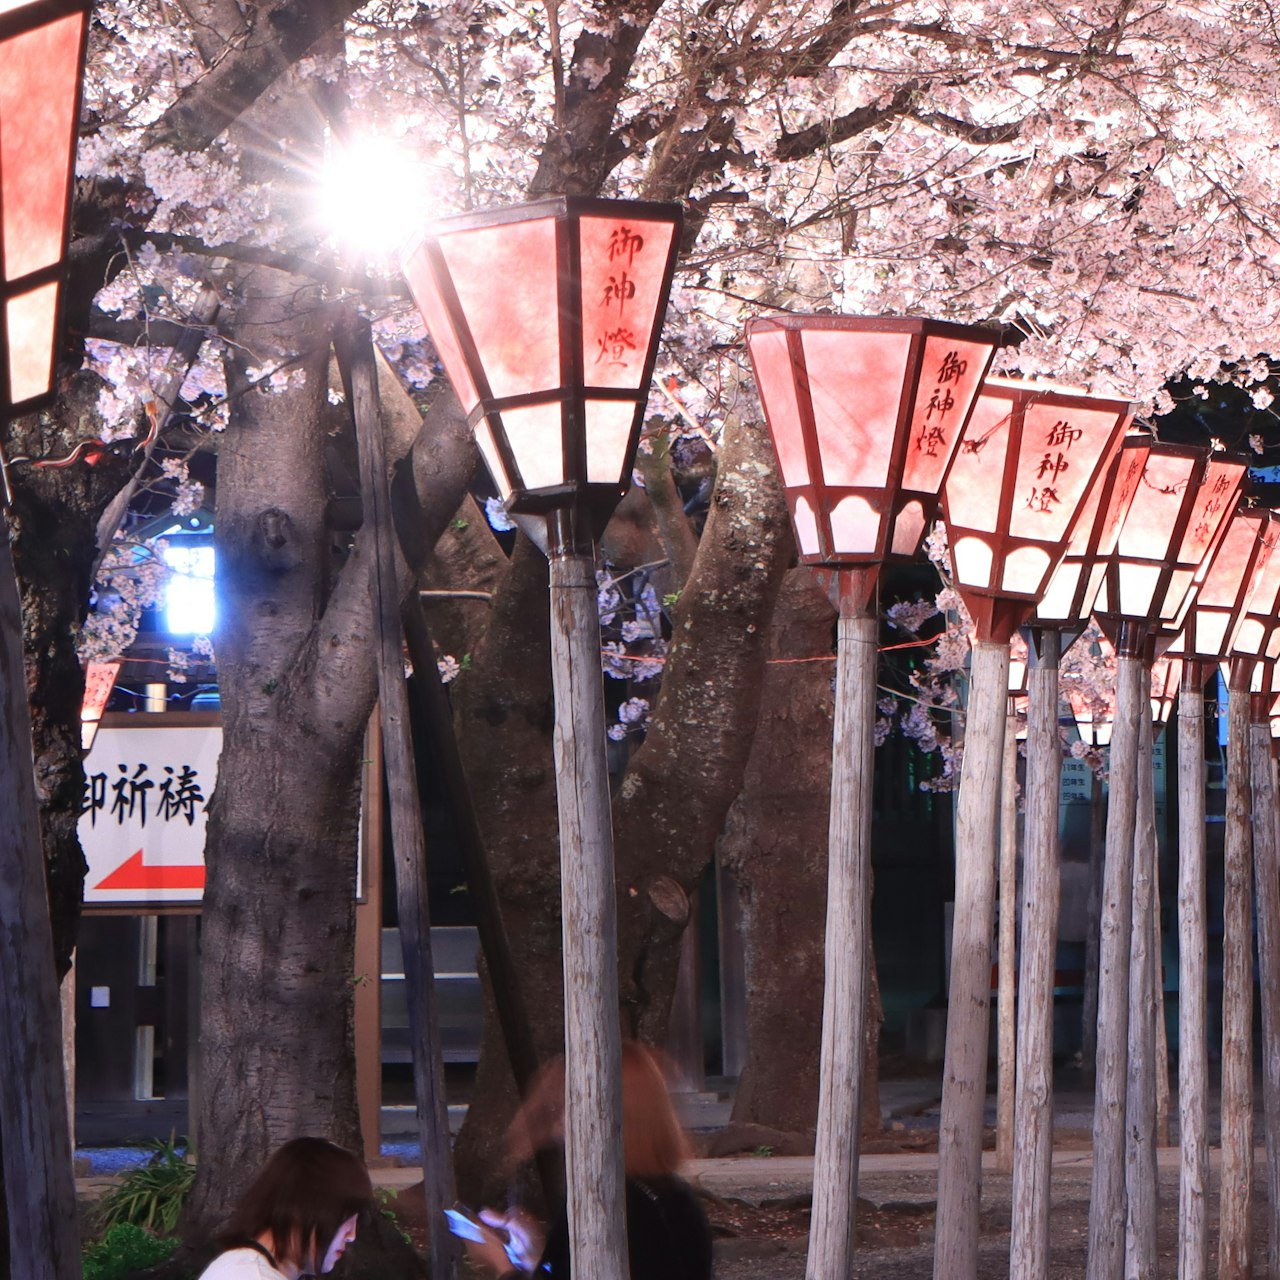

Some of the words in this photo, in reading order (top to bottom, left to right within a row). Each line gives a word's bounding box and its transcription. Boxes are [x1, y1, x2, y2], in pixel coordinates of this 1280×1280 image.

[596, 226, 643, 368] 御神燈
[912, 351, 967, 458] 御神燈
[1024, 420, 1082, 514] 御神燈
[1194, 474, 1230, 544] 御神燈
